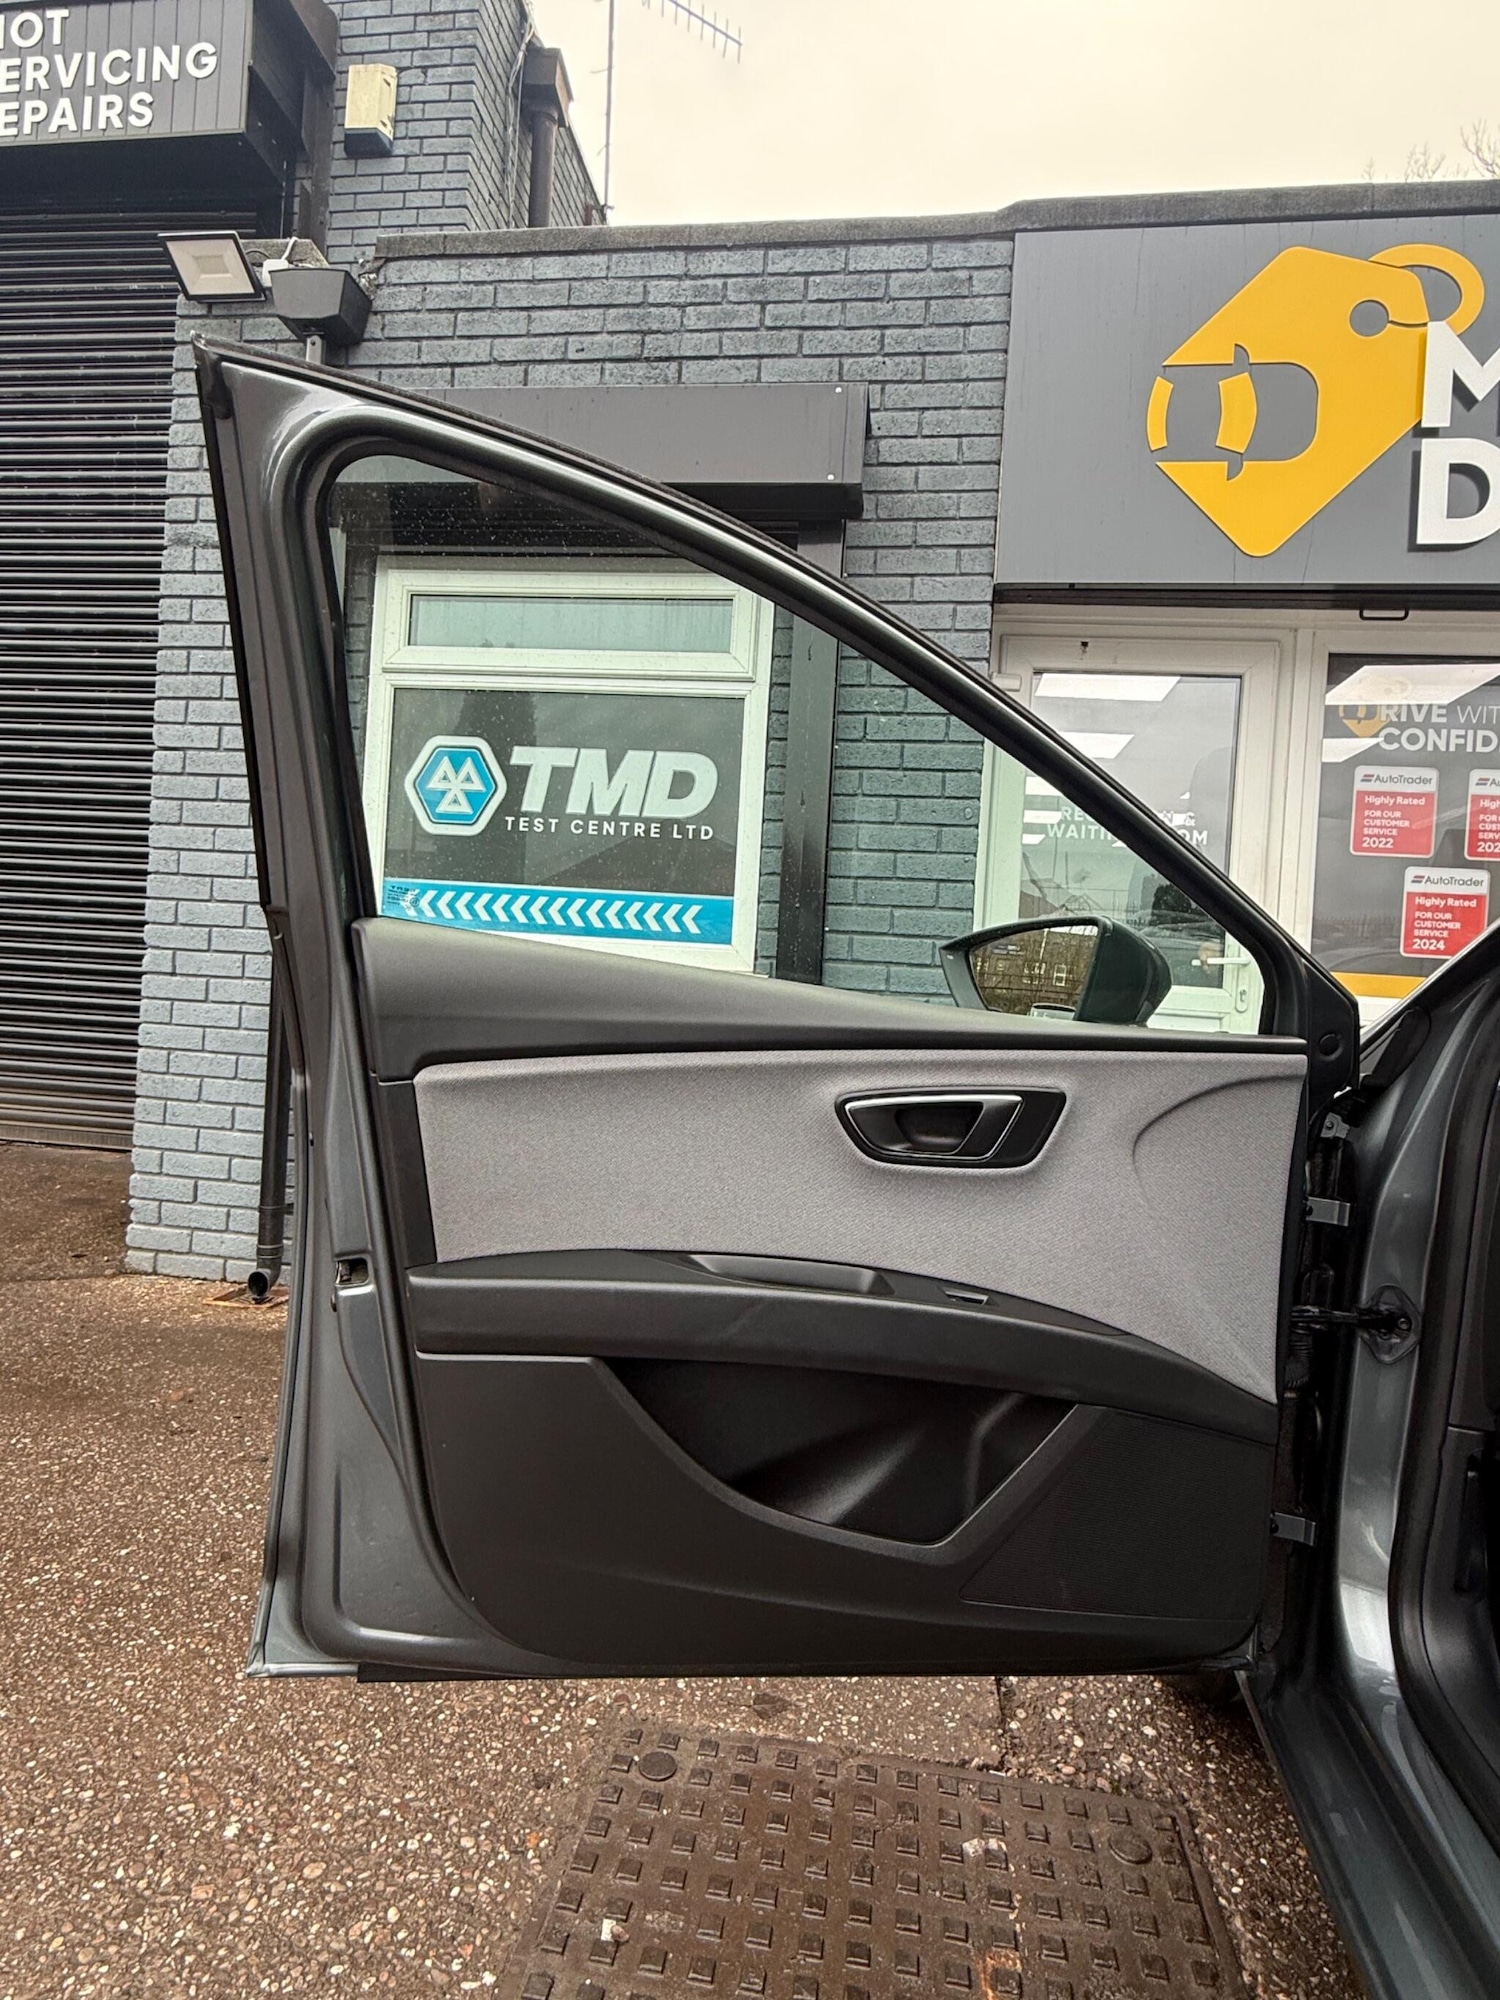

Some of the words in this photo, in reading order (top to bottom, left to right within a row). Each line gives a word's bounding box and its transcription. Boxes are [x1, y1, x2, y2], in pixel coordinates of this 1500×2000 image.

[0, 9, 69, 49] OT
[0, 42, 218, 93] ERVICING
[0, 92, 154, 136] EPAIRS
[1416, 438, 1500, 545] D
[1457, 705, 1500, 724] WIT
[1379, 727, 1499, 753] CONFID
[509, 745, 718, 819] TMD
[1374, 774, 1433, 785] AutoTrader
[1364, 795, 1395, 806] Highly
[1396, 796, 1425, 806] Rated
[1364, 810, 1382, 818] FOR
[1479, 814, 1497, 822] FOR
[505, 816, 559, 832] TEST
[570, 819, 661, 838] CENTRE
[672, 823, 714, 840] LTD
[1363, 819, 1410, 828] CUSTOMER
[1363, 828, 1398, 836] SERVICE
[1361, 837, 1394, 849] 2022
[1424, 876, 1484, 887] AutoTrader
[1414, 896, 1446, 907] Highly
[1447, 898, 1477, 907] Rated
[1413, 920, 1461, 929] CUSTOMER
[1413, 929, 1449, 937] SERVICE
[1412, 939, 1445, 950] 2024
